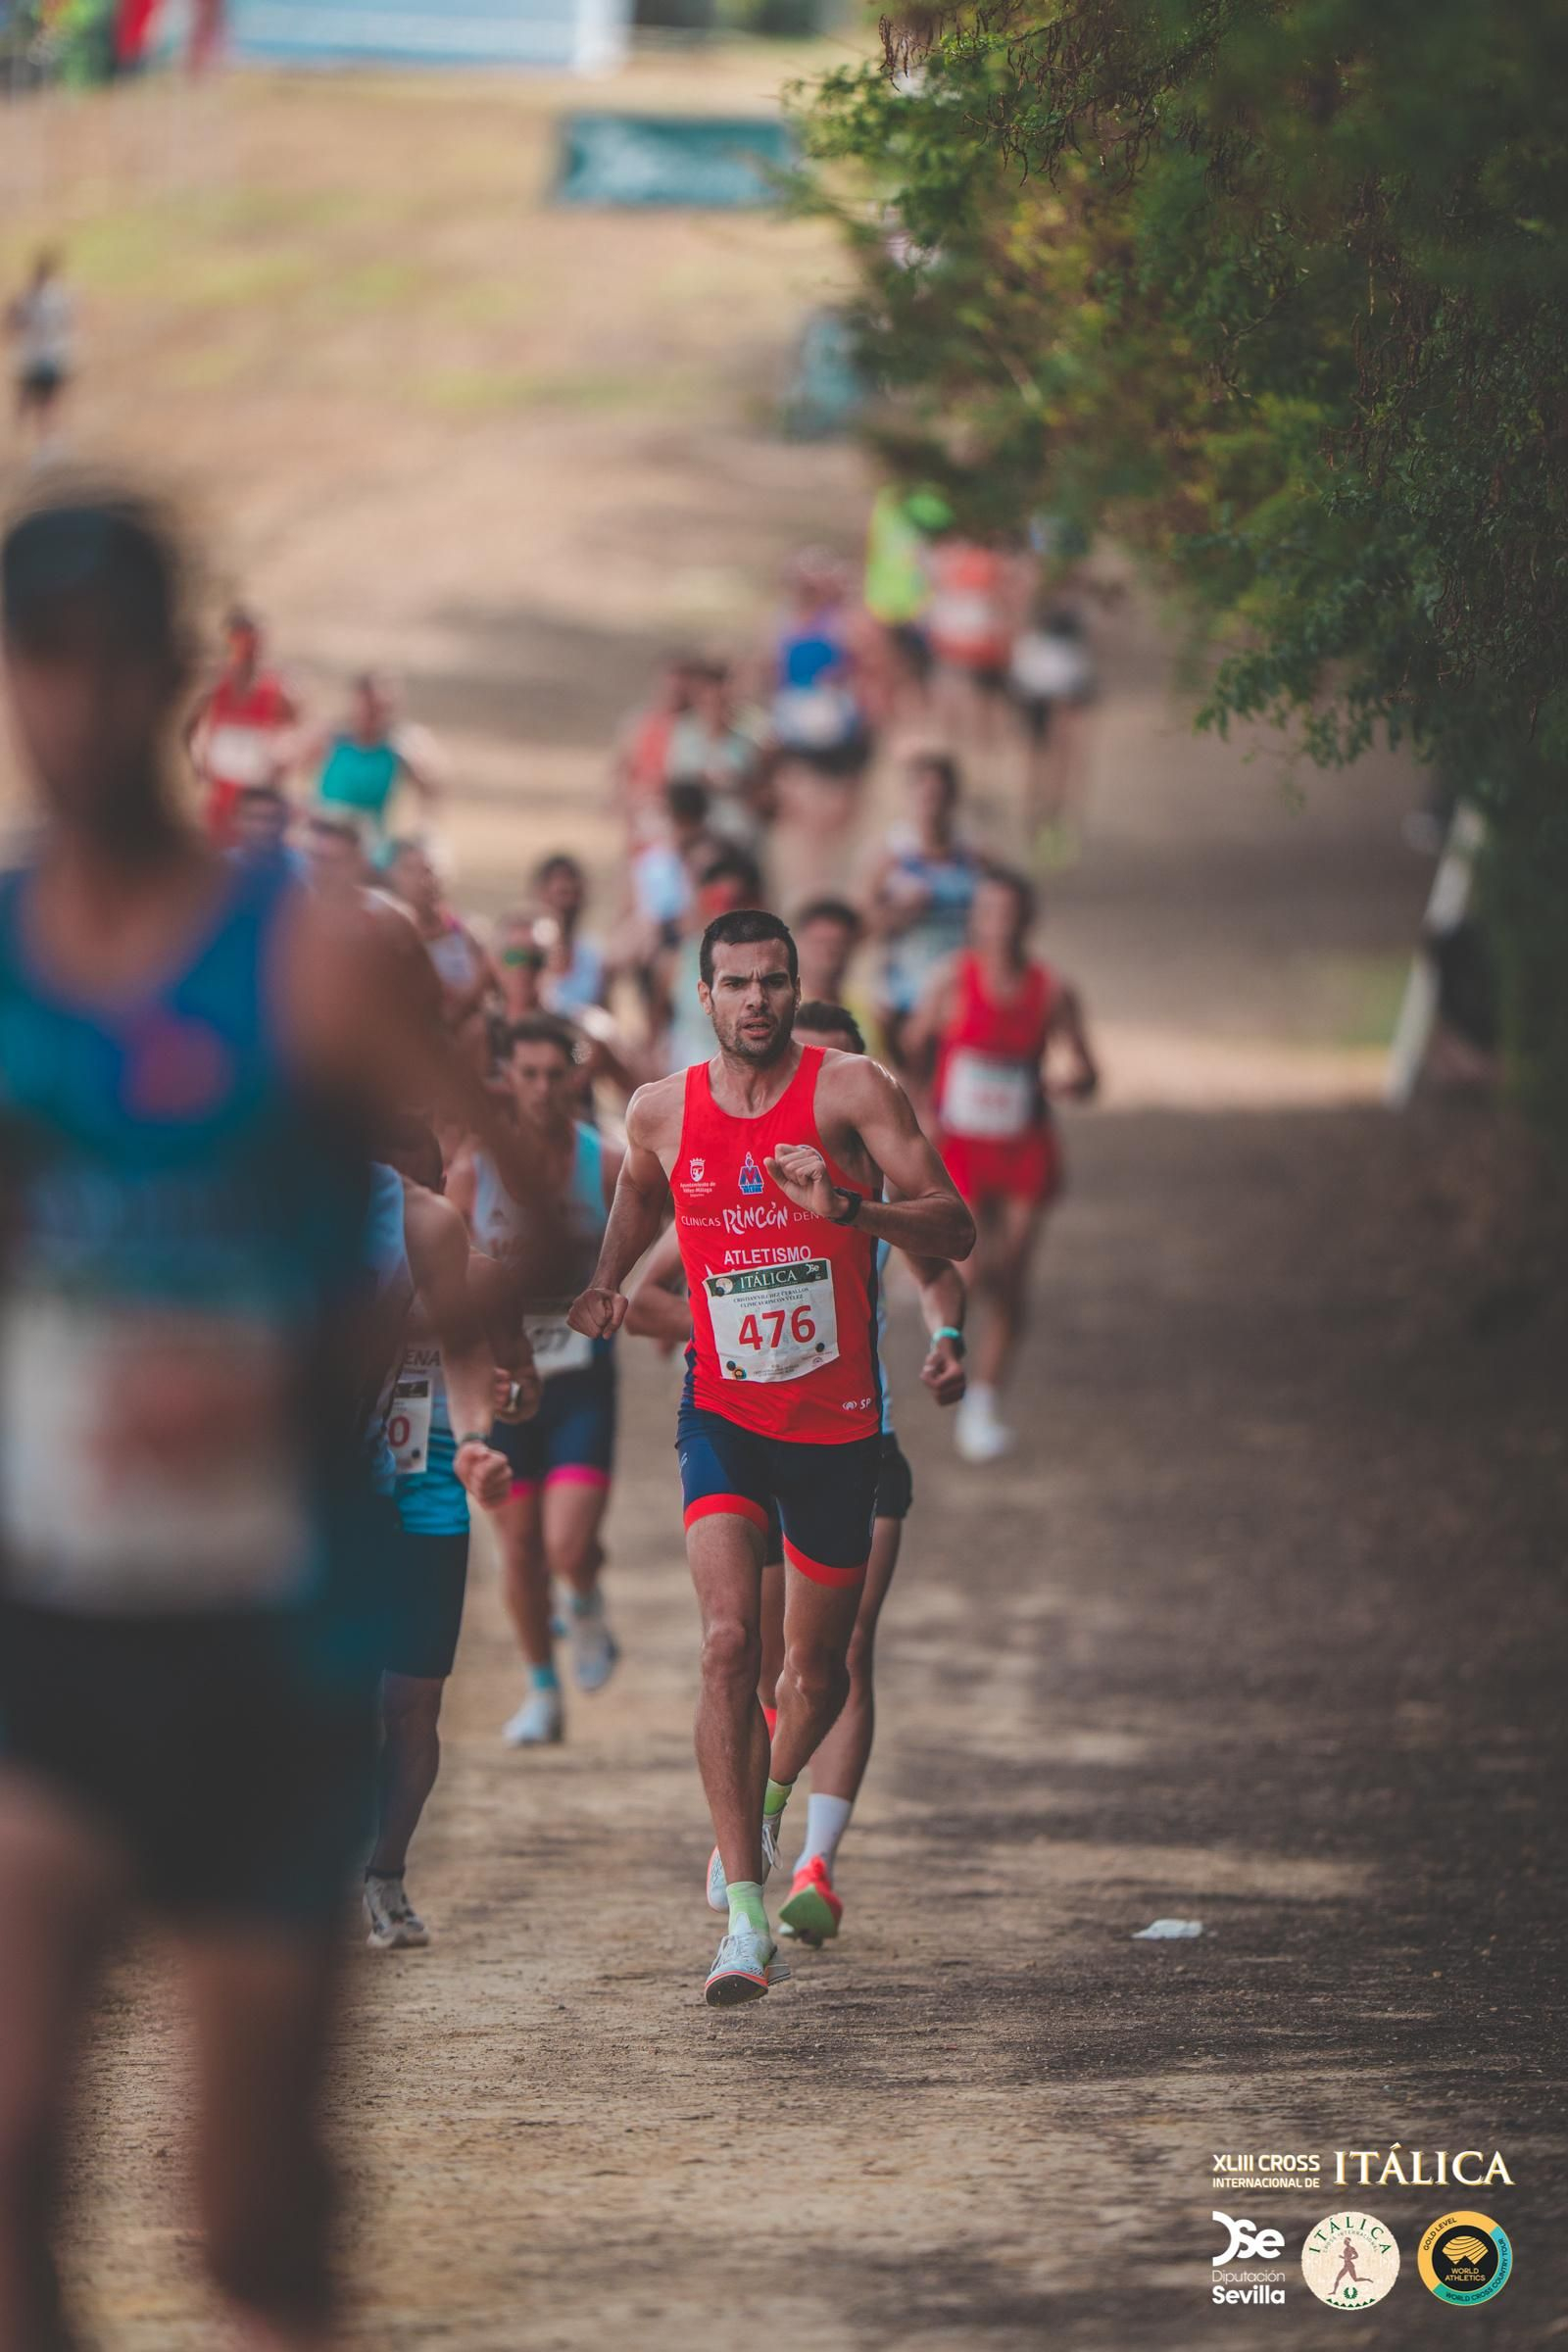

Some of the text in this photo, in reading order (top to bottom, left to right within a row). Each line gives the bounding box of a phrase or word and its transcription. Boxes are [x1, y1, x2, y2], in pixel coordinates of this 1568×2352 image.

[723, 1246, 811, 1265] ATLETISMO
[740, 1269, 798, 1289] ITÁLICA
[738, 1305, 816, 1350] 476
